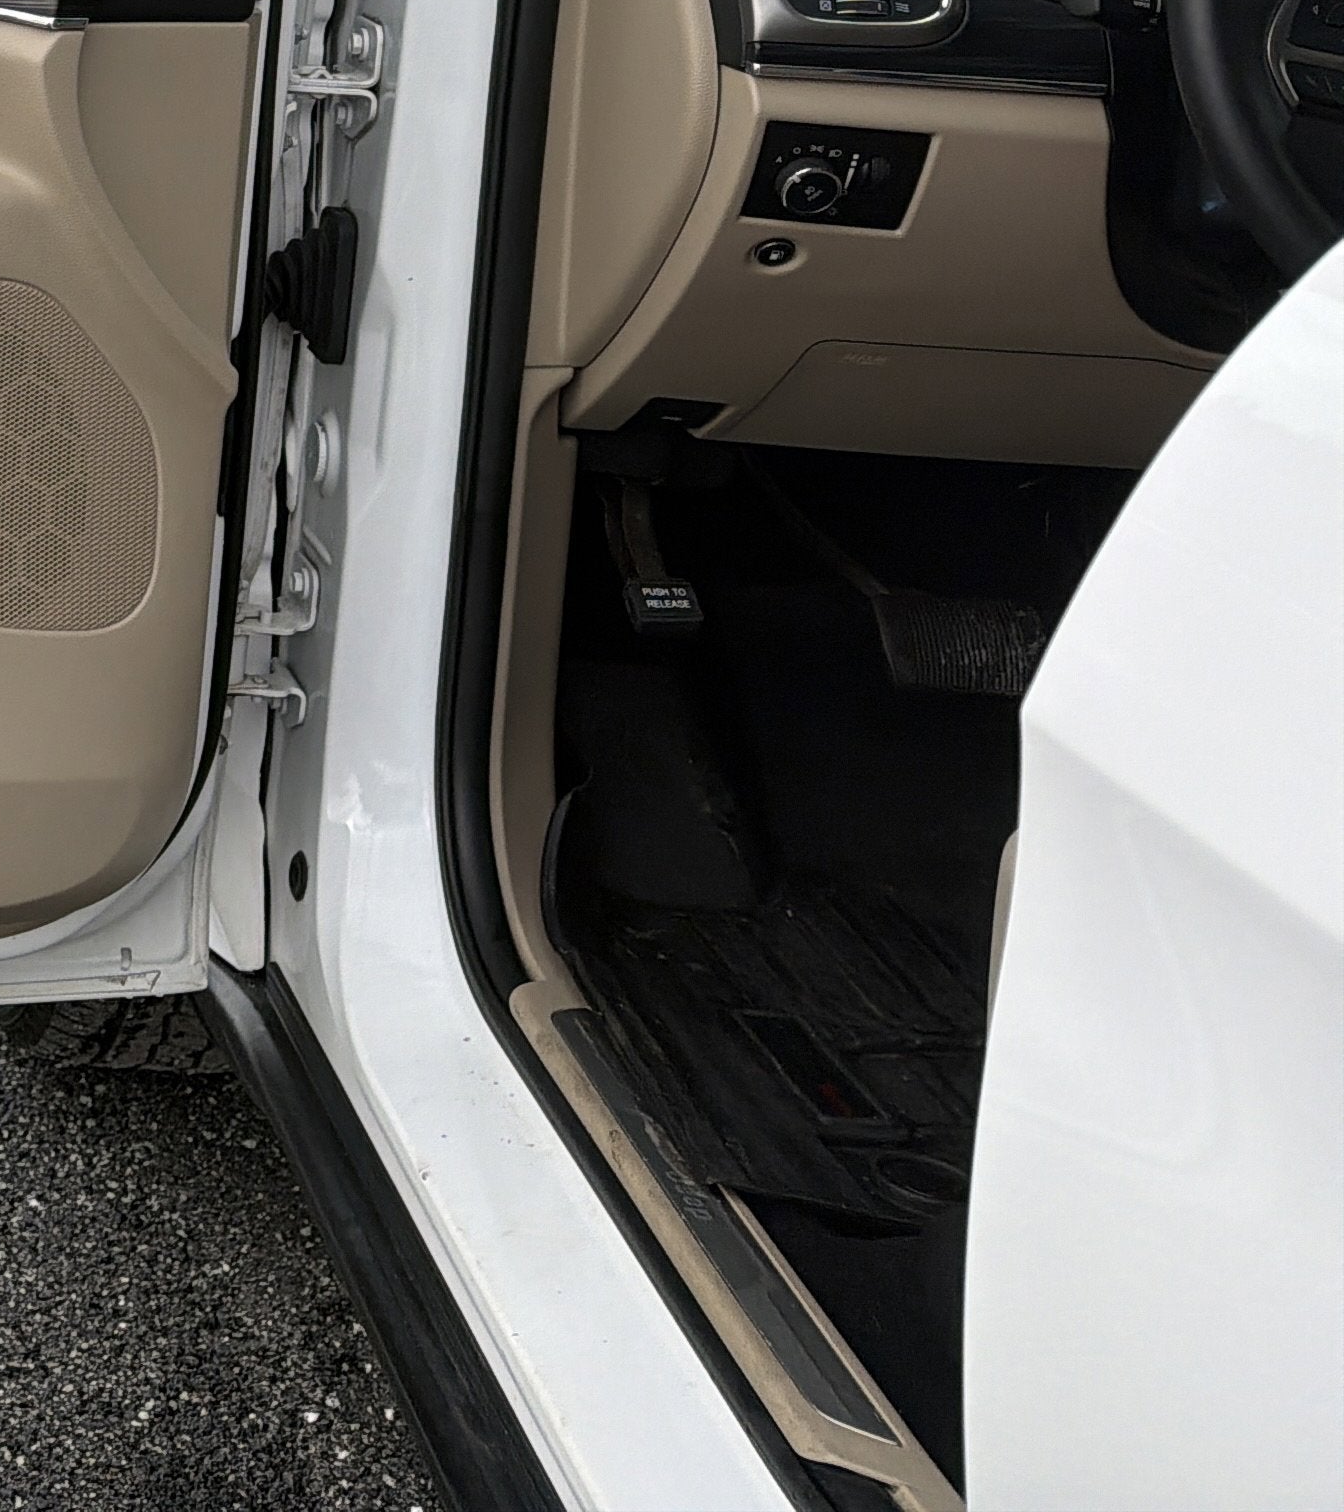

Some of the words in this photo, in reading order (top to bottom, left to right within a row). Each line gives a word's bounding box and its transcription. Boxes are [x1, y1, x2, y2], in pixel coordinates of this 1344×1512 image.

[641, 587, 670, 597] PUSH
[671, 587, 687, 597] TO
[645, 599, 692, 609] RELEASE
